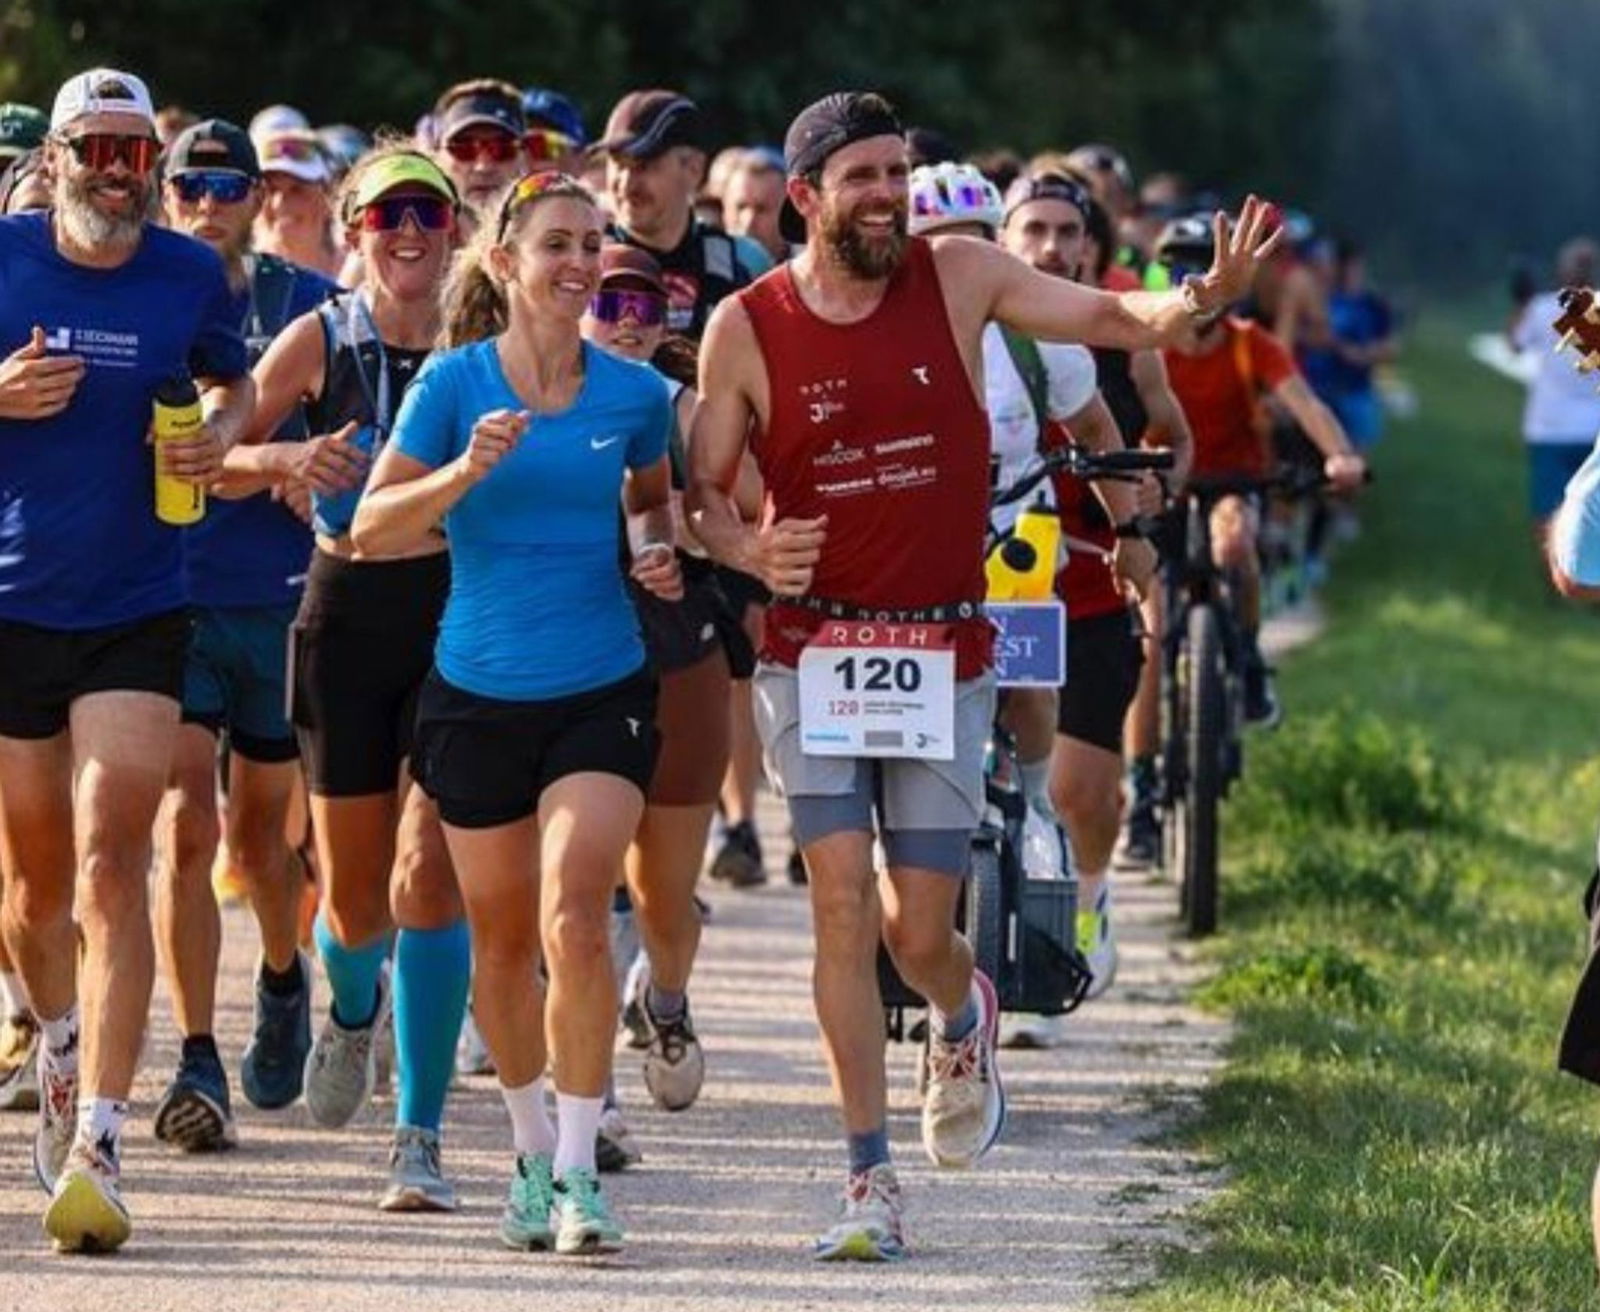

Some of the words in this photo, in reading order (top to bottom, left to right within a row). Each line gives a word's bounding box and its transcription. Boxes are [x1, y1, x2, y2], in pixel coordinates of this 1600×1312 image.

[831, 626, 928, 646] ROTH
[994, 636, 1040, 657] EST
[834, 655, 922, 693] 120
